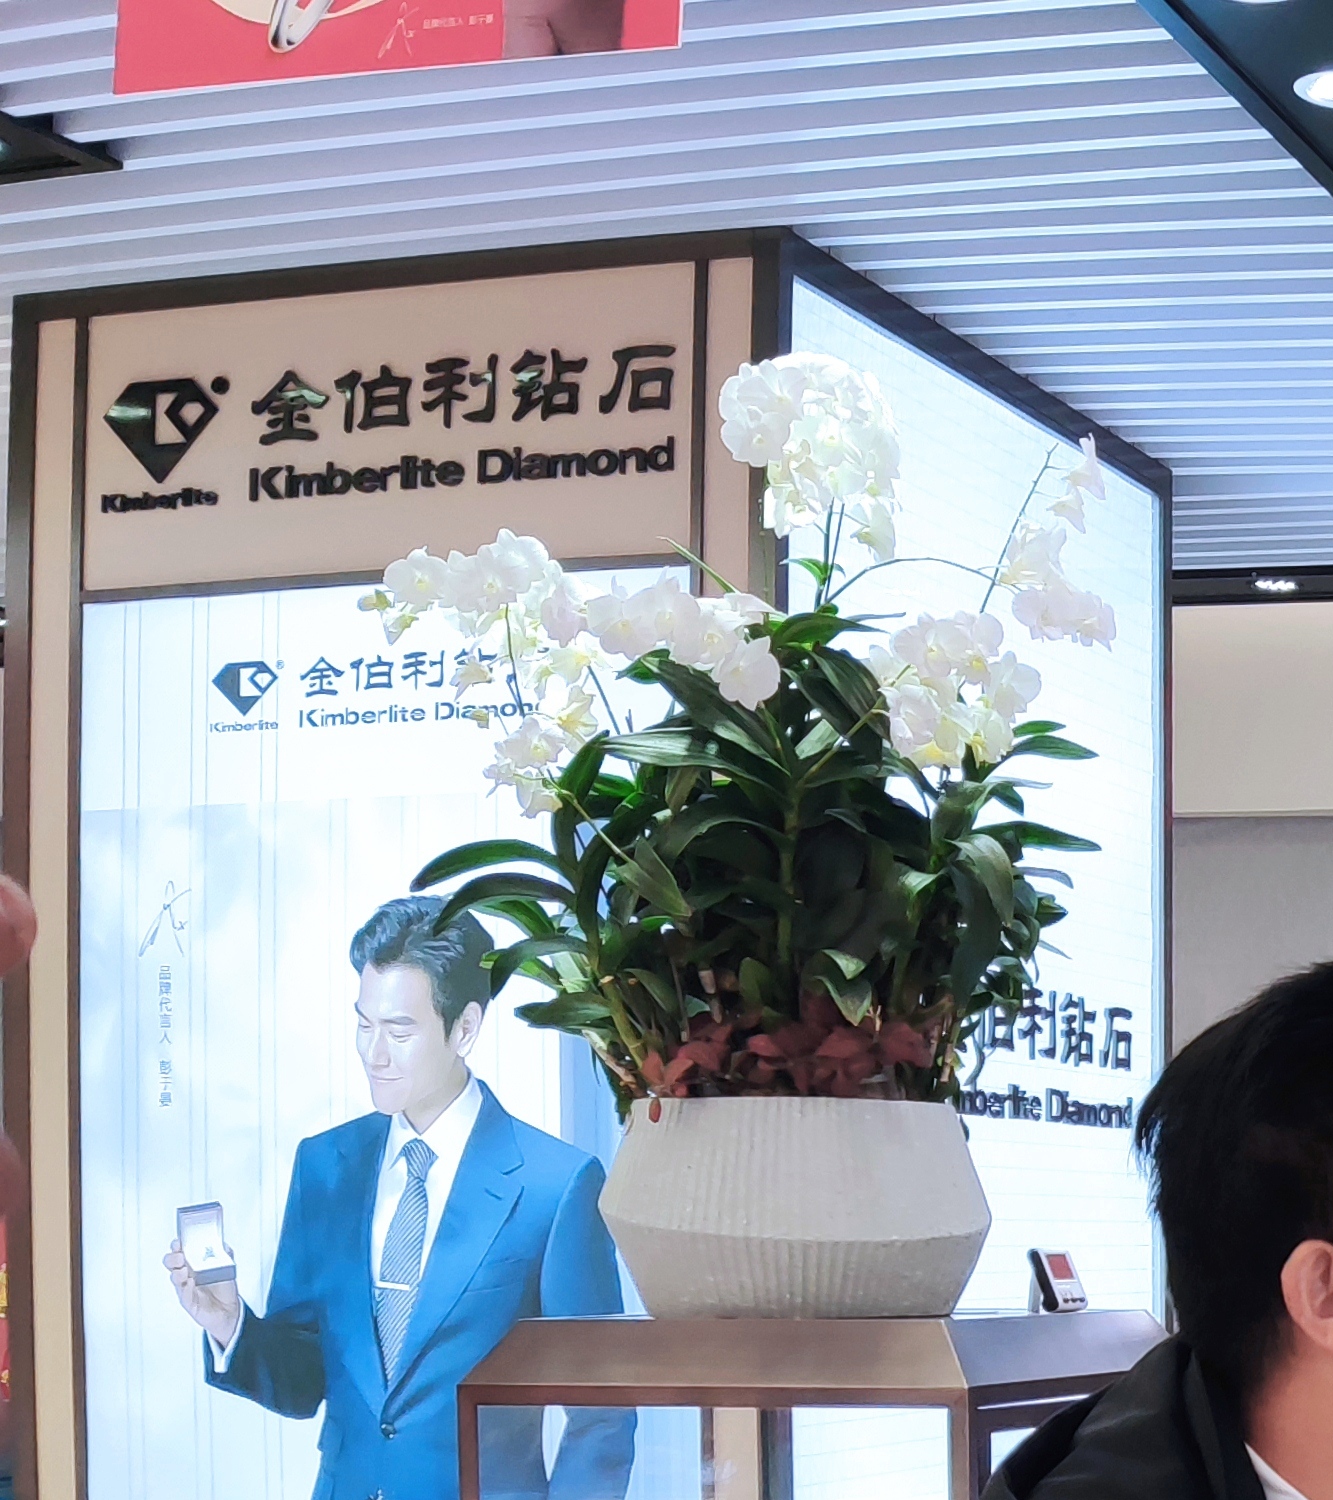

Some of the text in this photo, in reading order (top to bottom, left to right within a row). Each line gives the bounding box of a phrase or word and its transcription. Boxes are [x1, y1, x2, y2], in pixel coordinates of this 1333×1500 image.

[250, 344, 677, 447] 金伯利钻石
[249, 436, 676, 502] Kimberlite Diamond
[101, 487, 219, 513] Kimberlite
[299, 648, 550, 698] 金伯利
[210, 719, 279, 733] Kimberlite
[299, 701, 540, 728] Kimberlite Diamon
[955, 988, 1133, 1072] 伯利钻石
